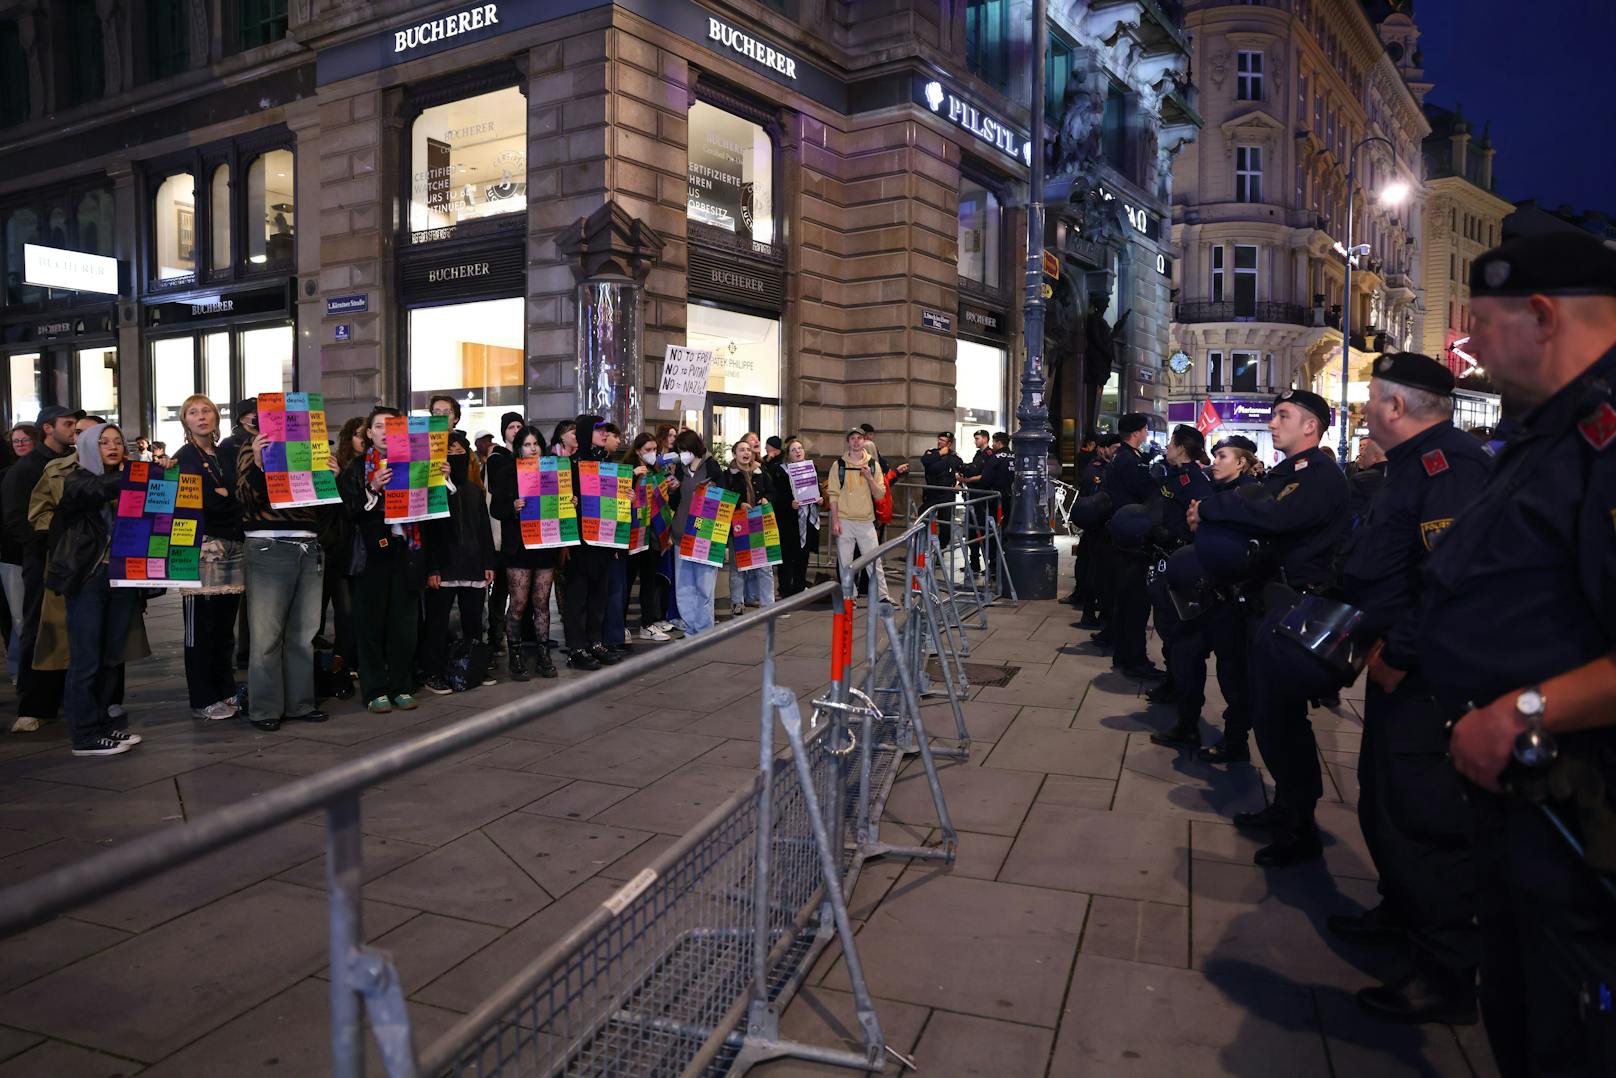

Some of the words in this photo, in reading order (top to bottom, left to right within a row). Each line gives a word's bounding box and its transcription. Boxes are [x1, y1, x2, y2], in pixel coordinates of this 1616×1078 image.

[394, 3, 499, 53] BUCHERER
[708, 17, 797, 80] BUCHERER
[444, 121, 495, 142] BUCHERER
[948, 94, 1019, 157] PILSTL
[414, 165, 457, 182] CERTIFIED
[687, 161, 742, 188] ERTIFIZIERTE
[688, 174, 713, 190] HREN
[414, 179, 451, 194] WATCHE
[687, 189, 701, 199] US
[687, 198, 729, 219] ORBESITZ
[428, 262, 491, 283] BUCHERER
[711, 269, 764, 292] BUCHERER
[191, 300, 234, 316] BUCHERER
[965, 310, 997, 328] BUCHERER
[338, 326, 345, 335] 2
[670, 348, 682, 362] NO
[686, 351, 694, 362] TO
[665, 364, 679, 376] NO
[728, 358, 754, 371] PHILIPPE
[662, 376, 676, 390] NO
